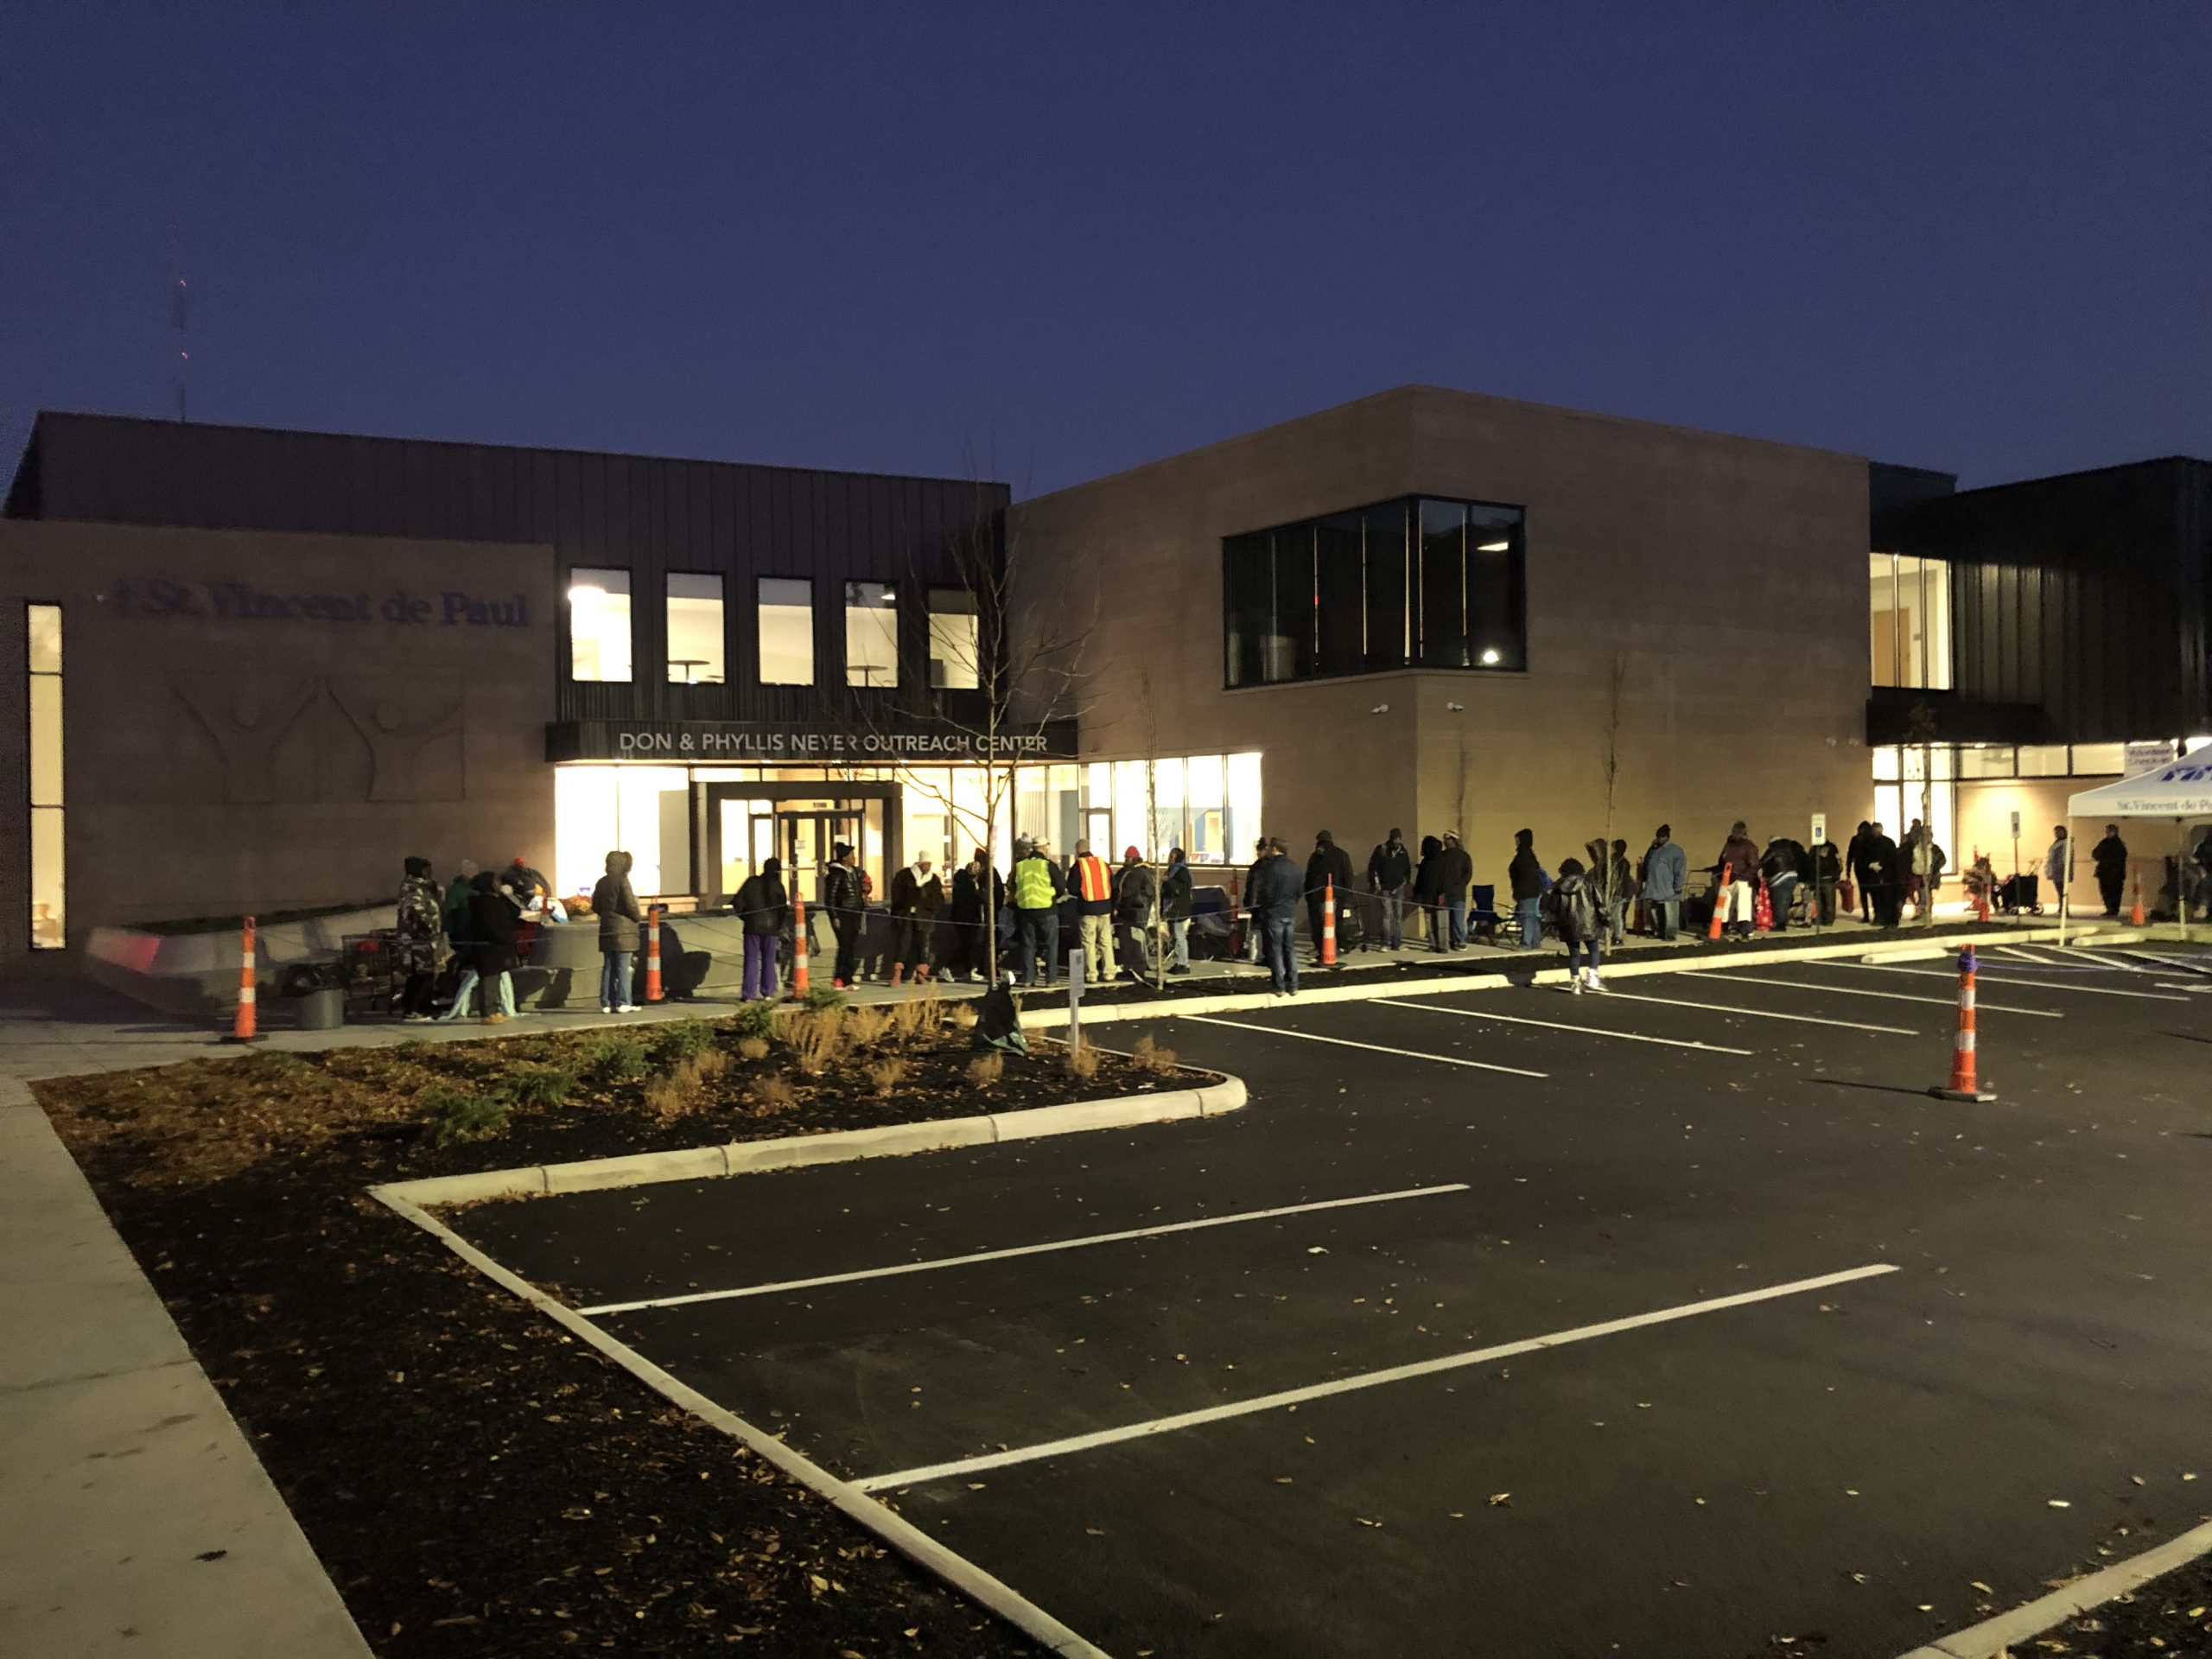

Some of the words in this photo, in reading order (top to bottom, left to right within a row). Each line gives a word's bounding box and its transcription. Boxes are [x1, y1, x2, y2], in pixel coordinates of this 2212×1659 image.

[380, 588, 433, 625] de
[440, 588, 529, 627] Paul
[620, 733, 672, 750] DON
[678, 733, 695, 750] &
[702, 733, 785, 751] PHYLLIS
[791, 734, 858, 752] NEYER
[864, 734, 969, 752] OUTREACH
[976, 734, 1048, 752] CENTER
